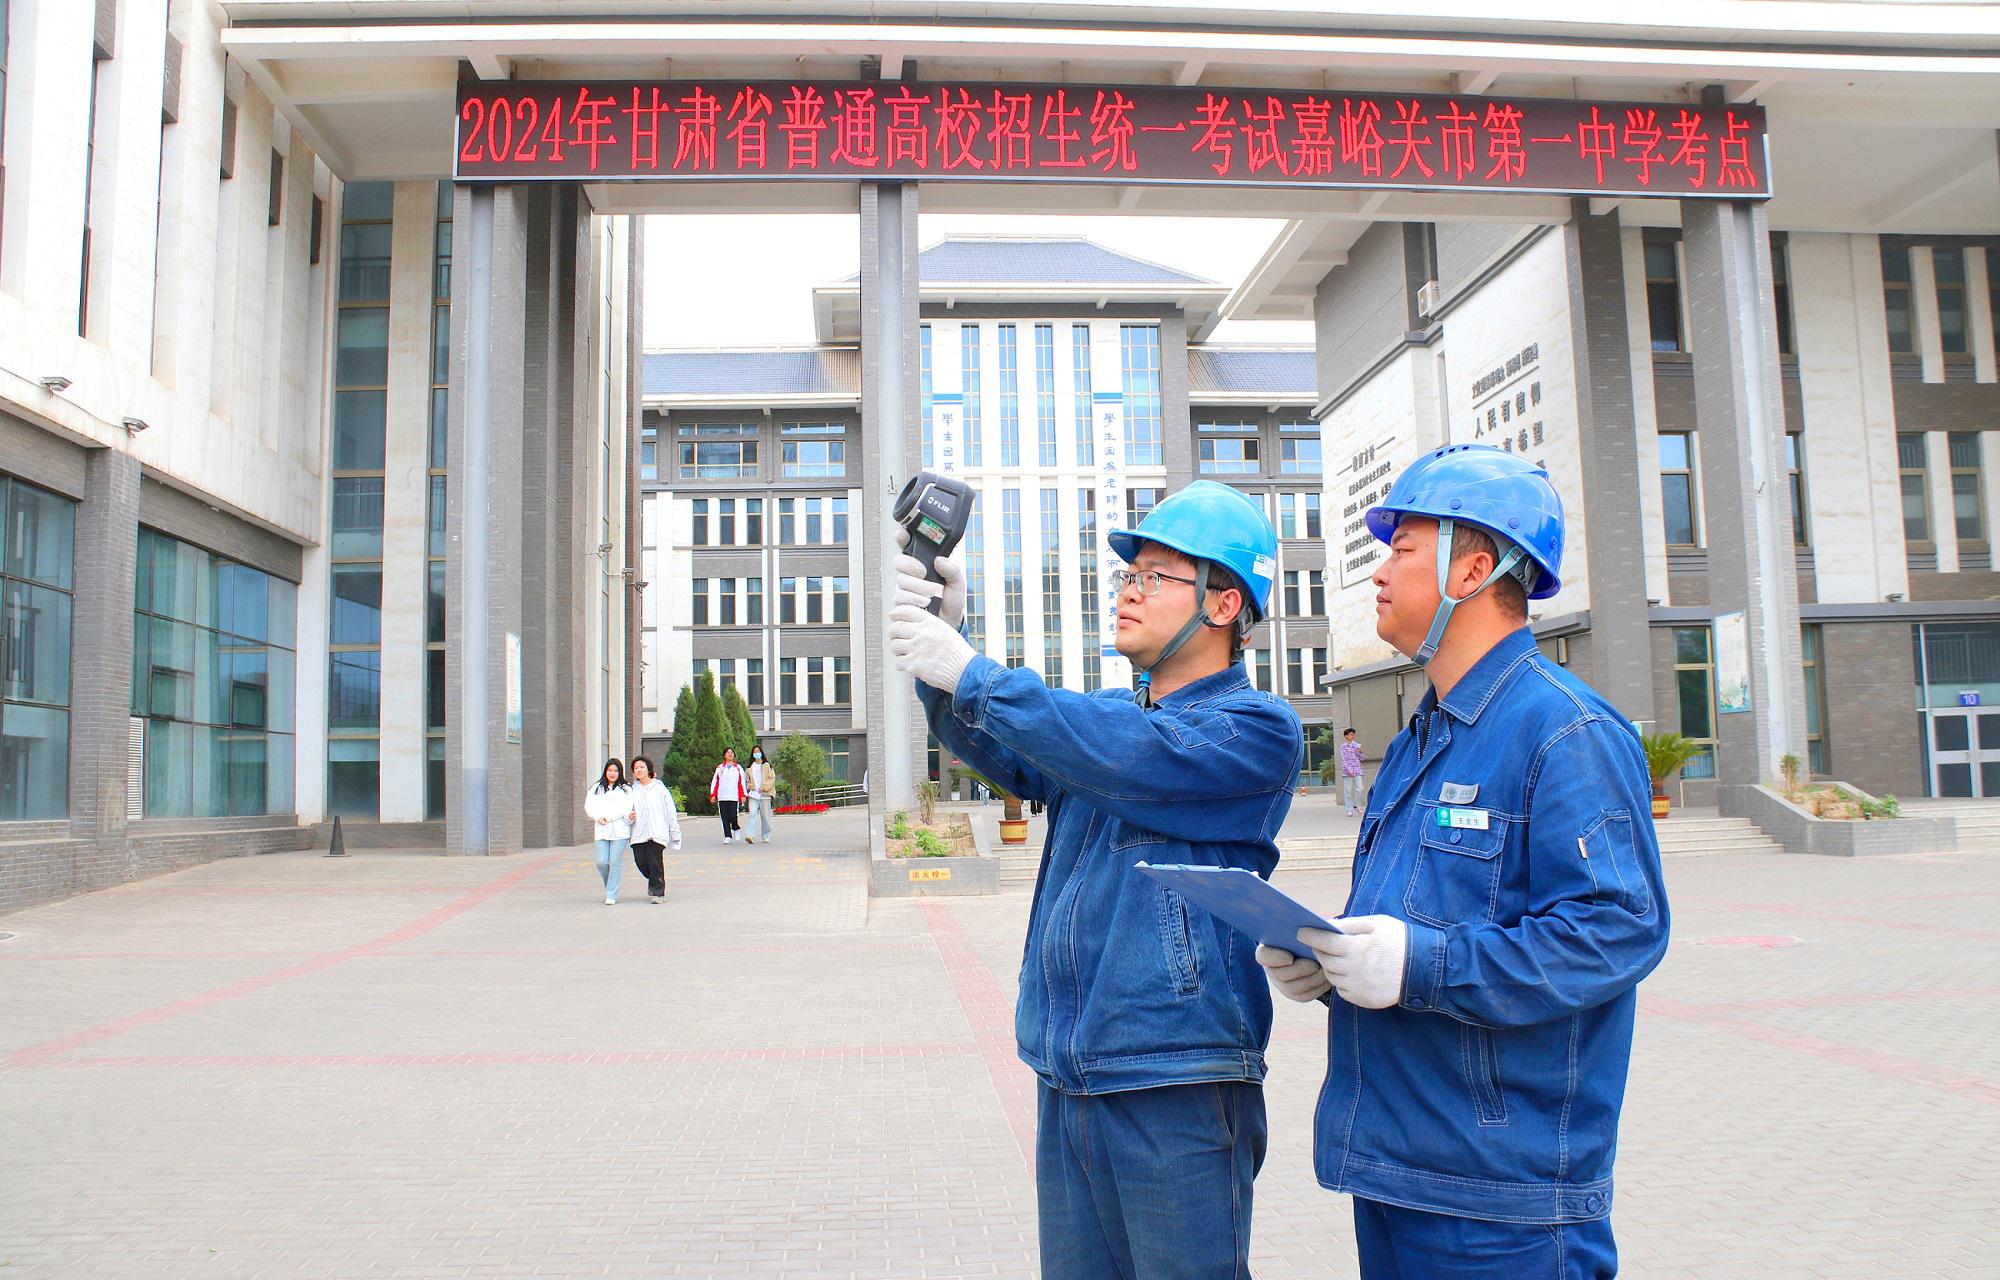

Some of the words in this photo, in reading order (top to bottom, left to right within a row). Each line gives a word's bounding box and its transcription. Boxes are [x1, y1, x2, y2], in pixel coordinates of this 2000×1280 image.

[461, 86, 1756, 188] 2024年甘肃省普通高校招生统一考试嘉峪关市第一中学考点
[933, 501, 950, 513] FLIR
[1962, 694, 1977, 705] 10
